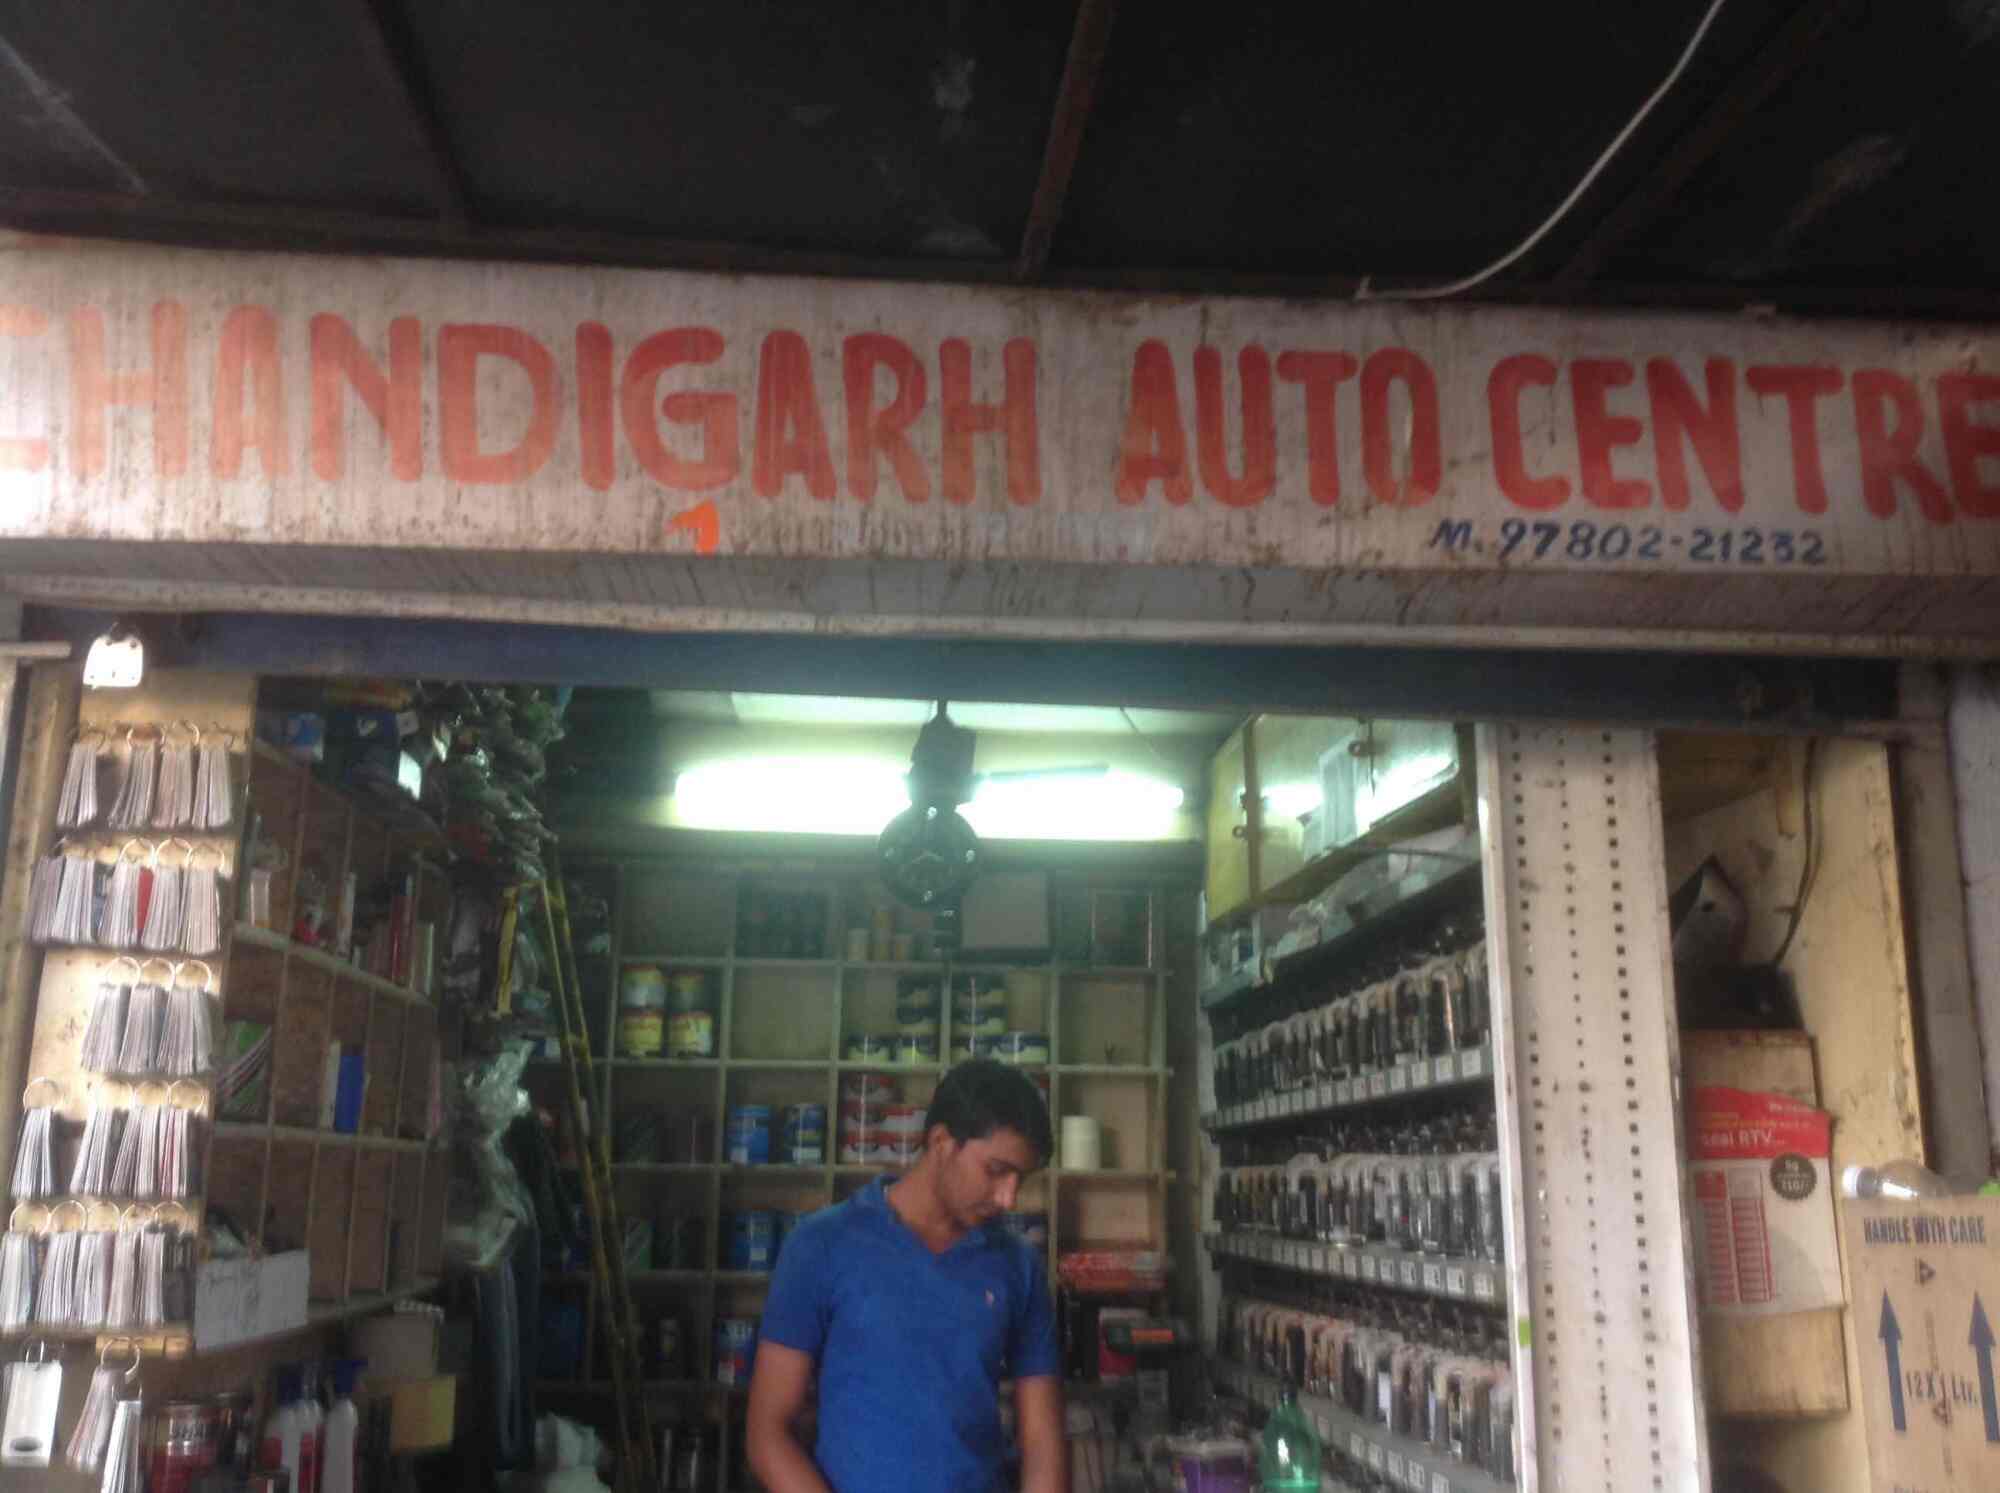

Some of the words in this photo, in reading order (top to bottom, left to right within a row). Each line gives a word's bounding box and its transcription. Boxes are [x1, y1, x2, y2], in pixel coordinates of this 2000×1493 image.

[1114, 338, 1444, 508] AUTO
[1487, 351, 2000, 526] CENTRE
[1429, 517, 1484, 555] M.
[1497, 516, 1828, 567] 97802-21232
[1862, 1215, 1911, 1244] HANDLE
[1912, 1215, 1947, 1244] WITH
[1947, 1215, 1986, 1245] CARE
